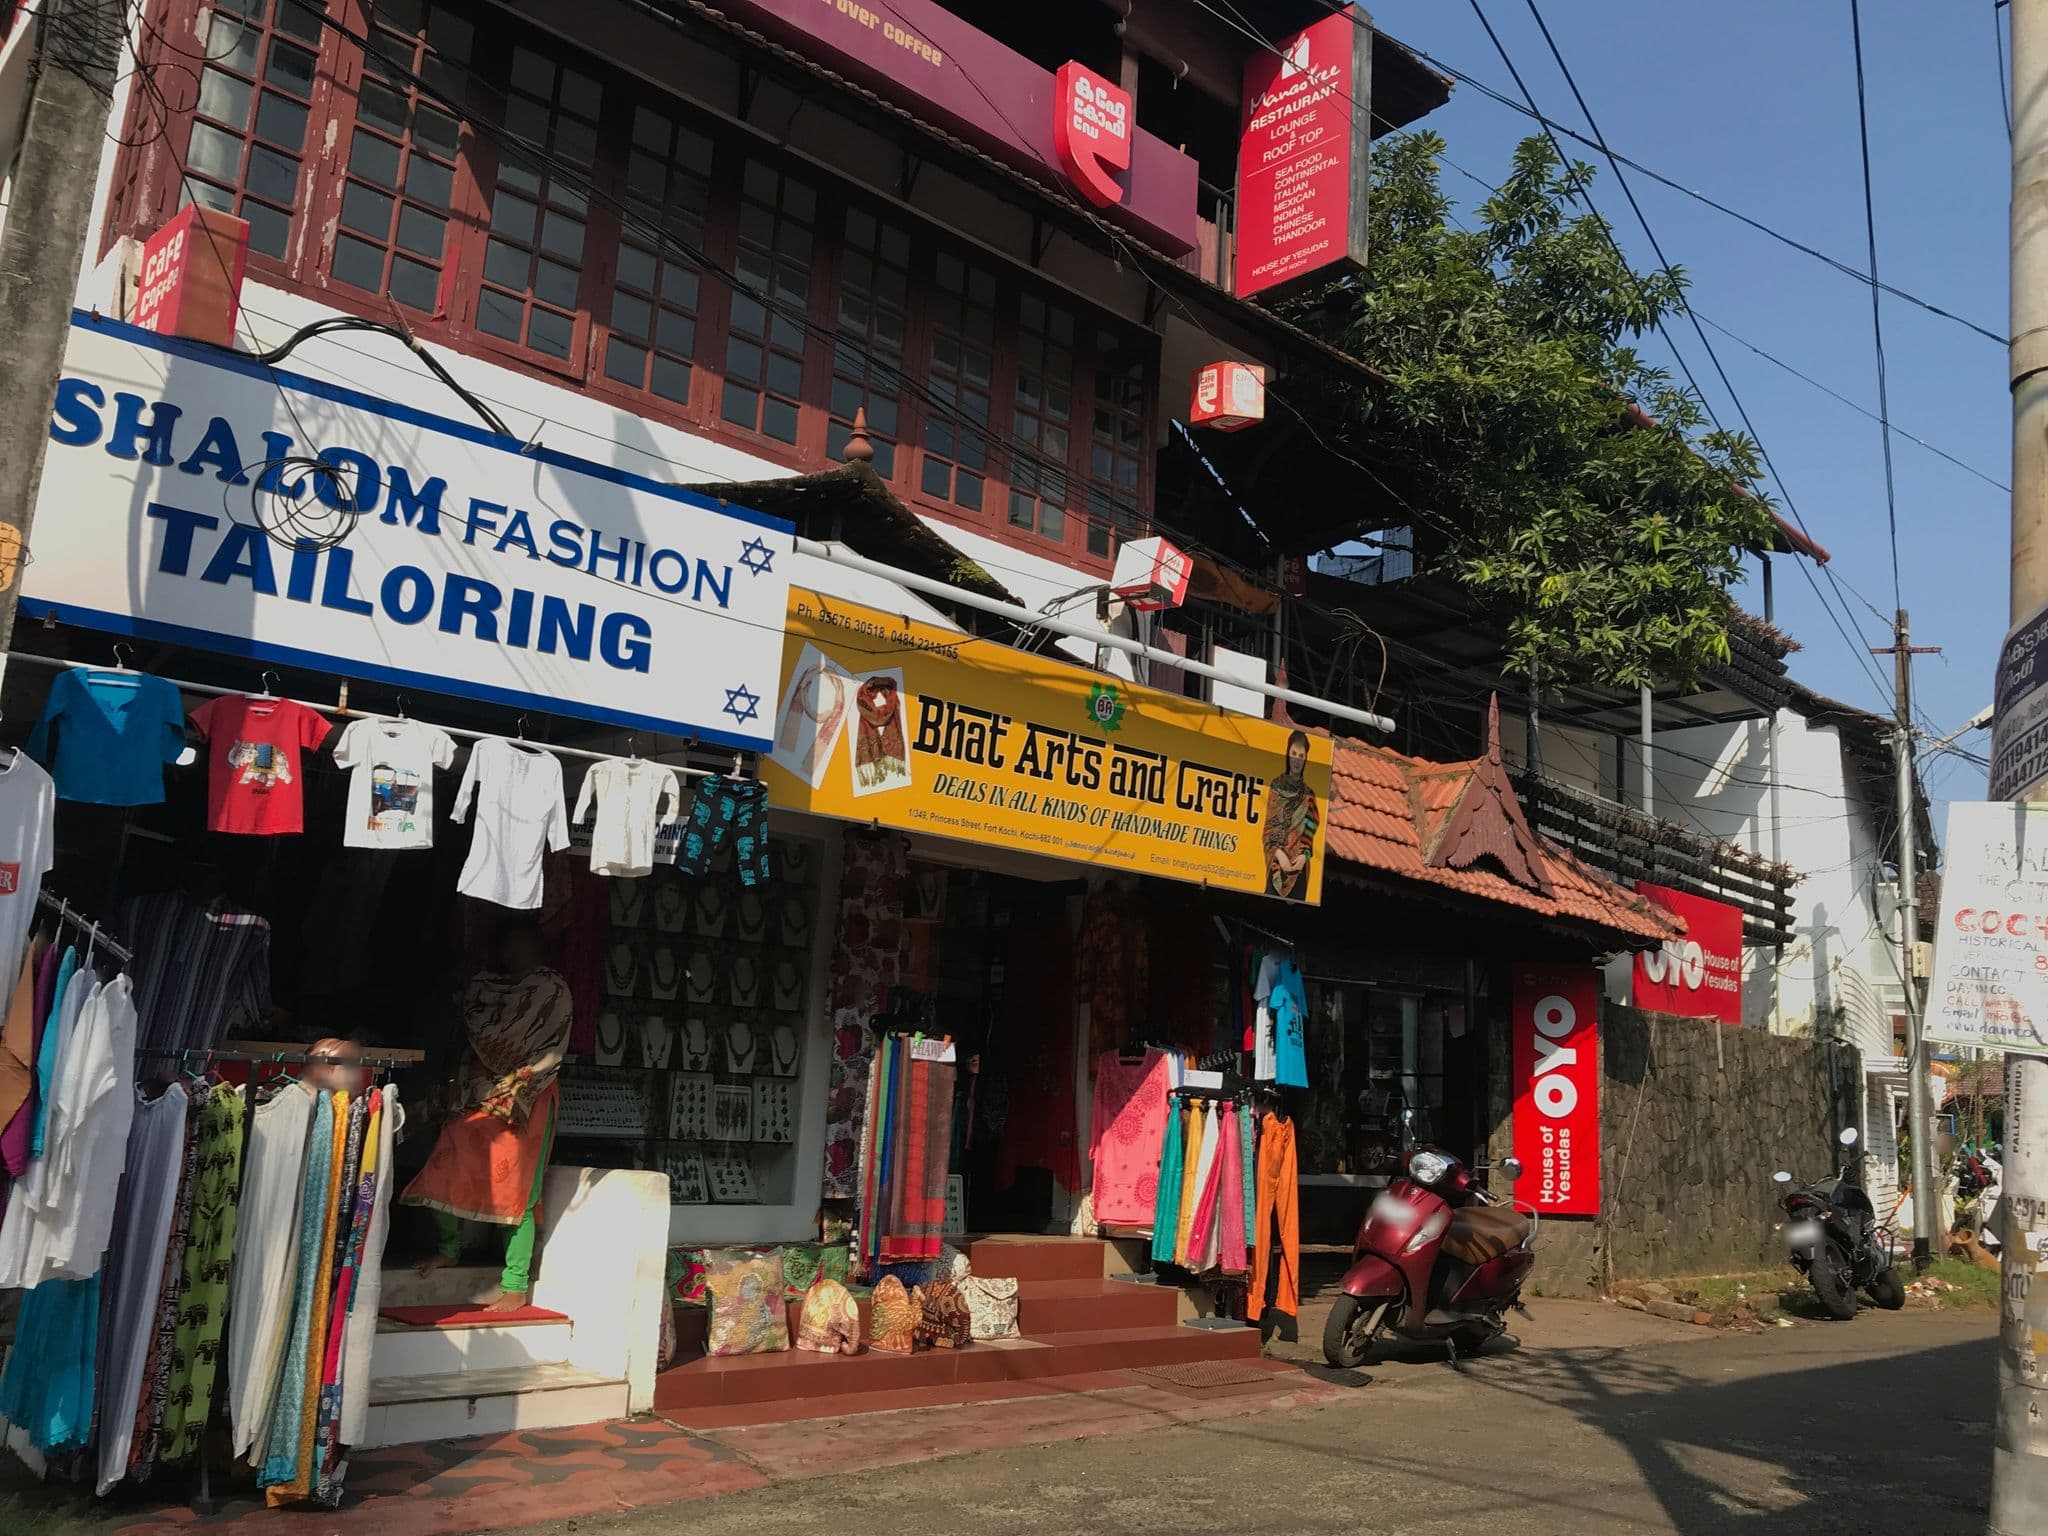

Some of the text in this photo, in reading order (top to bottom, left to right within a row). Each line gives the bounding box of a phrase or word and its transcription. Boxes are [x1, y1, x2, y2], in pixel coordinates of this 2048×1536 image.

[1250, 81, 1339, 132] RESTAURANT
[1270, 110, 1317, 140] LOUNGE
[1290, 130, 1297, 140] &
[1263, 127, 1324, 163] ROOF TOP
[1274, 156, 1340, 190] CONTINENTAL
[1275, 152, 1323, 180] SEA FOOD
[1273, 188, 1316, 213] MEXICAN
[1274, 180, 1309, 202] ITALIAN
[1272, 211, 1314, 235] CHINESE
[1273, 204, 1305, 224] INDIAN
[1272, 217, 1326, 246] THANDOOR
[1252, 239, 1329, 277] HOUSE OF YESUDAS
[50, 378, 733, 609] SHALOM FASHION
[147, 502, 652, 674] TAILORING
[818, 609, 851, 629] 95676
[1097, 698, 1113, 714] BA
[912, 694, 1264, 825] Bhat Arts and Craft
[930, 811, 960, 827] Princess
[983, 822, 998, 834] Fort
[932, 772, 1238, 852] DEALS IN ALL KINDS OF HANDMADE THINGS
[1643, 938, 1739, 990] OYO House of
[1703, 969, 1738, 992] Yesudas
[1533, 995, 1578, 1119] OYO
[1540, 1125, 1554, 1204] House of
[1556, 1127, 1571, 1204] Yesudas
